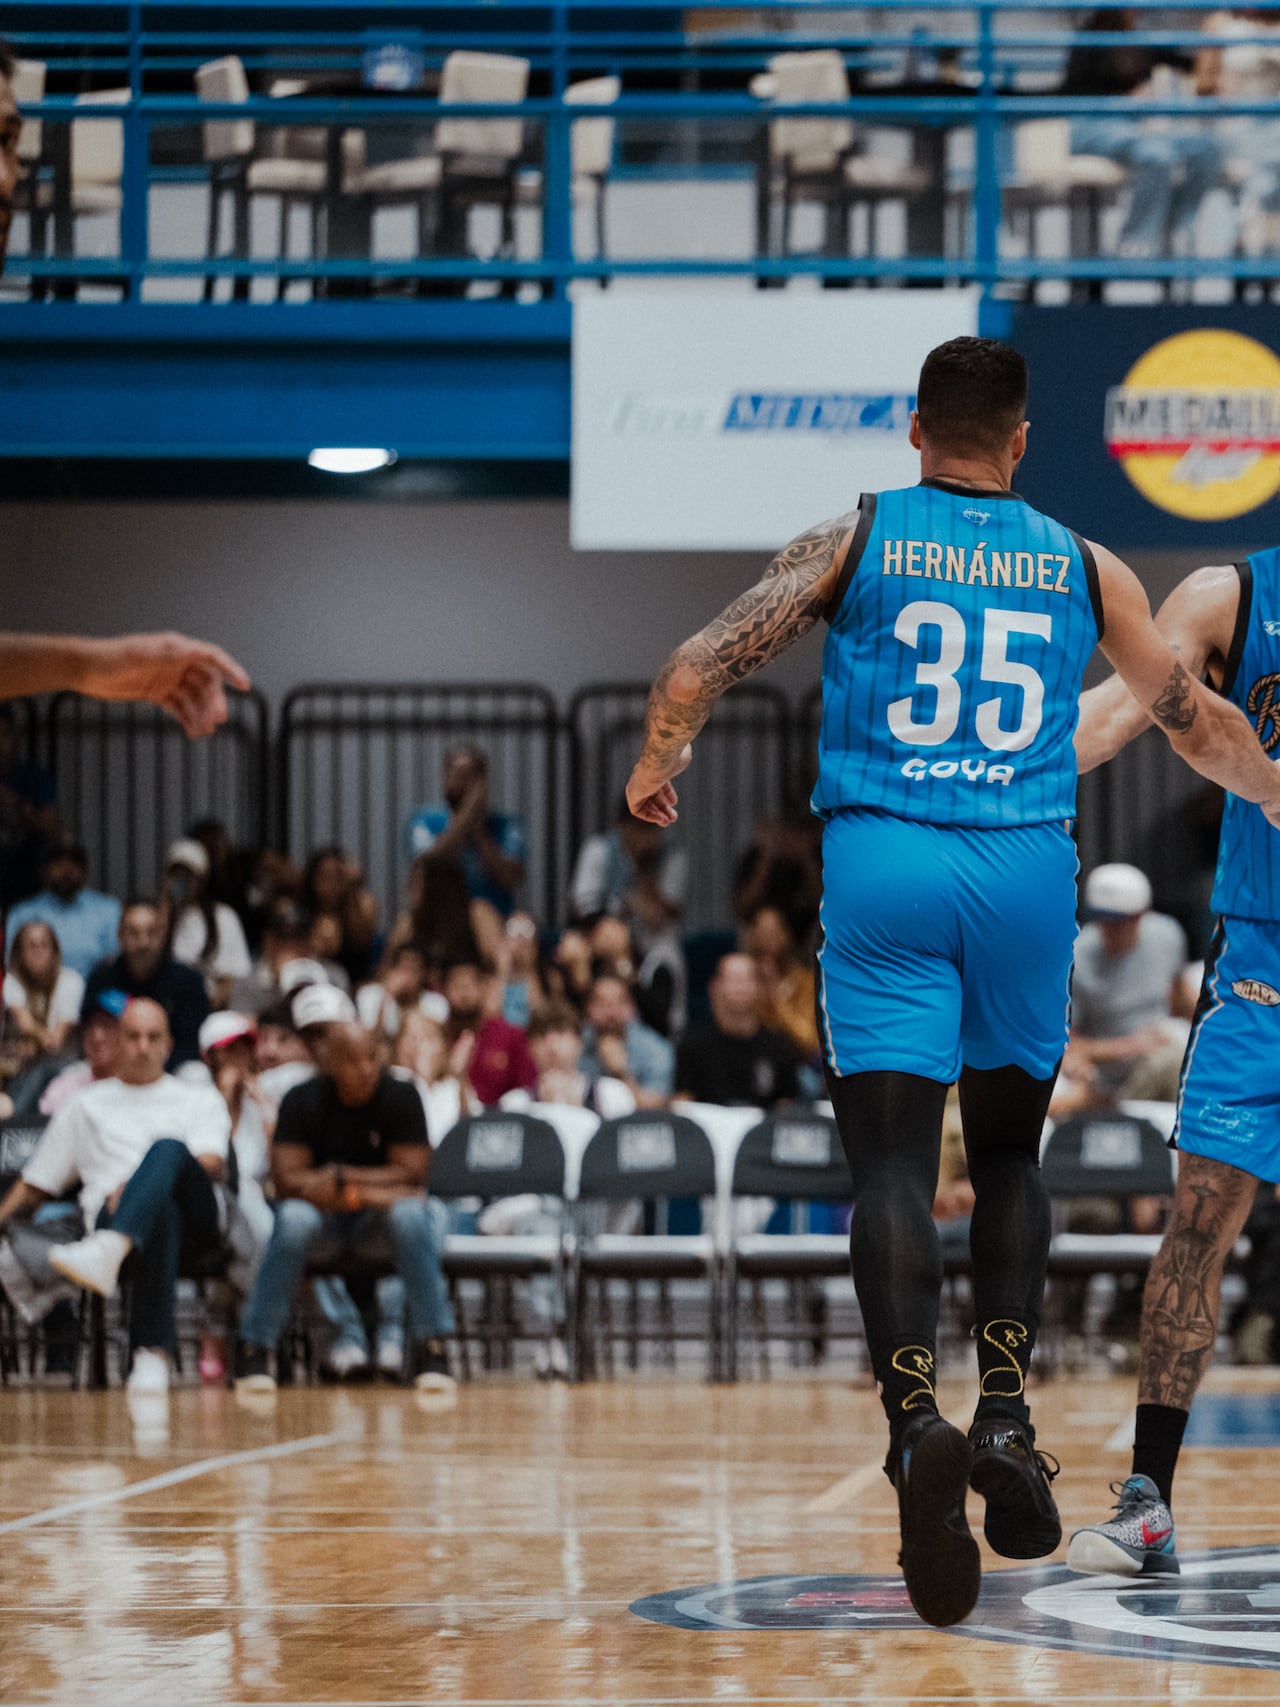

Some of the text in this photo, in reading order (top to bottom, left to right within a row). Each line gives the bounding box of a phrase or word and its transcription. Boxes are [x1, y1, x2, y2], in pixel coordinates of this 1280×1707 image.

[729, 394, 915, 431] MEDICA
[881, 539, 1071, 595] HERNÁNDEZ
[887, 600, 1052, 752] 35
[900, 757, 1015, 786] GOYA
